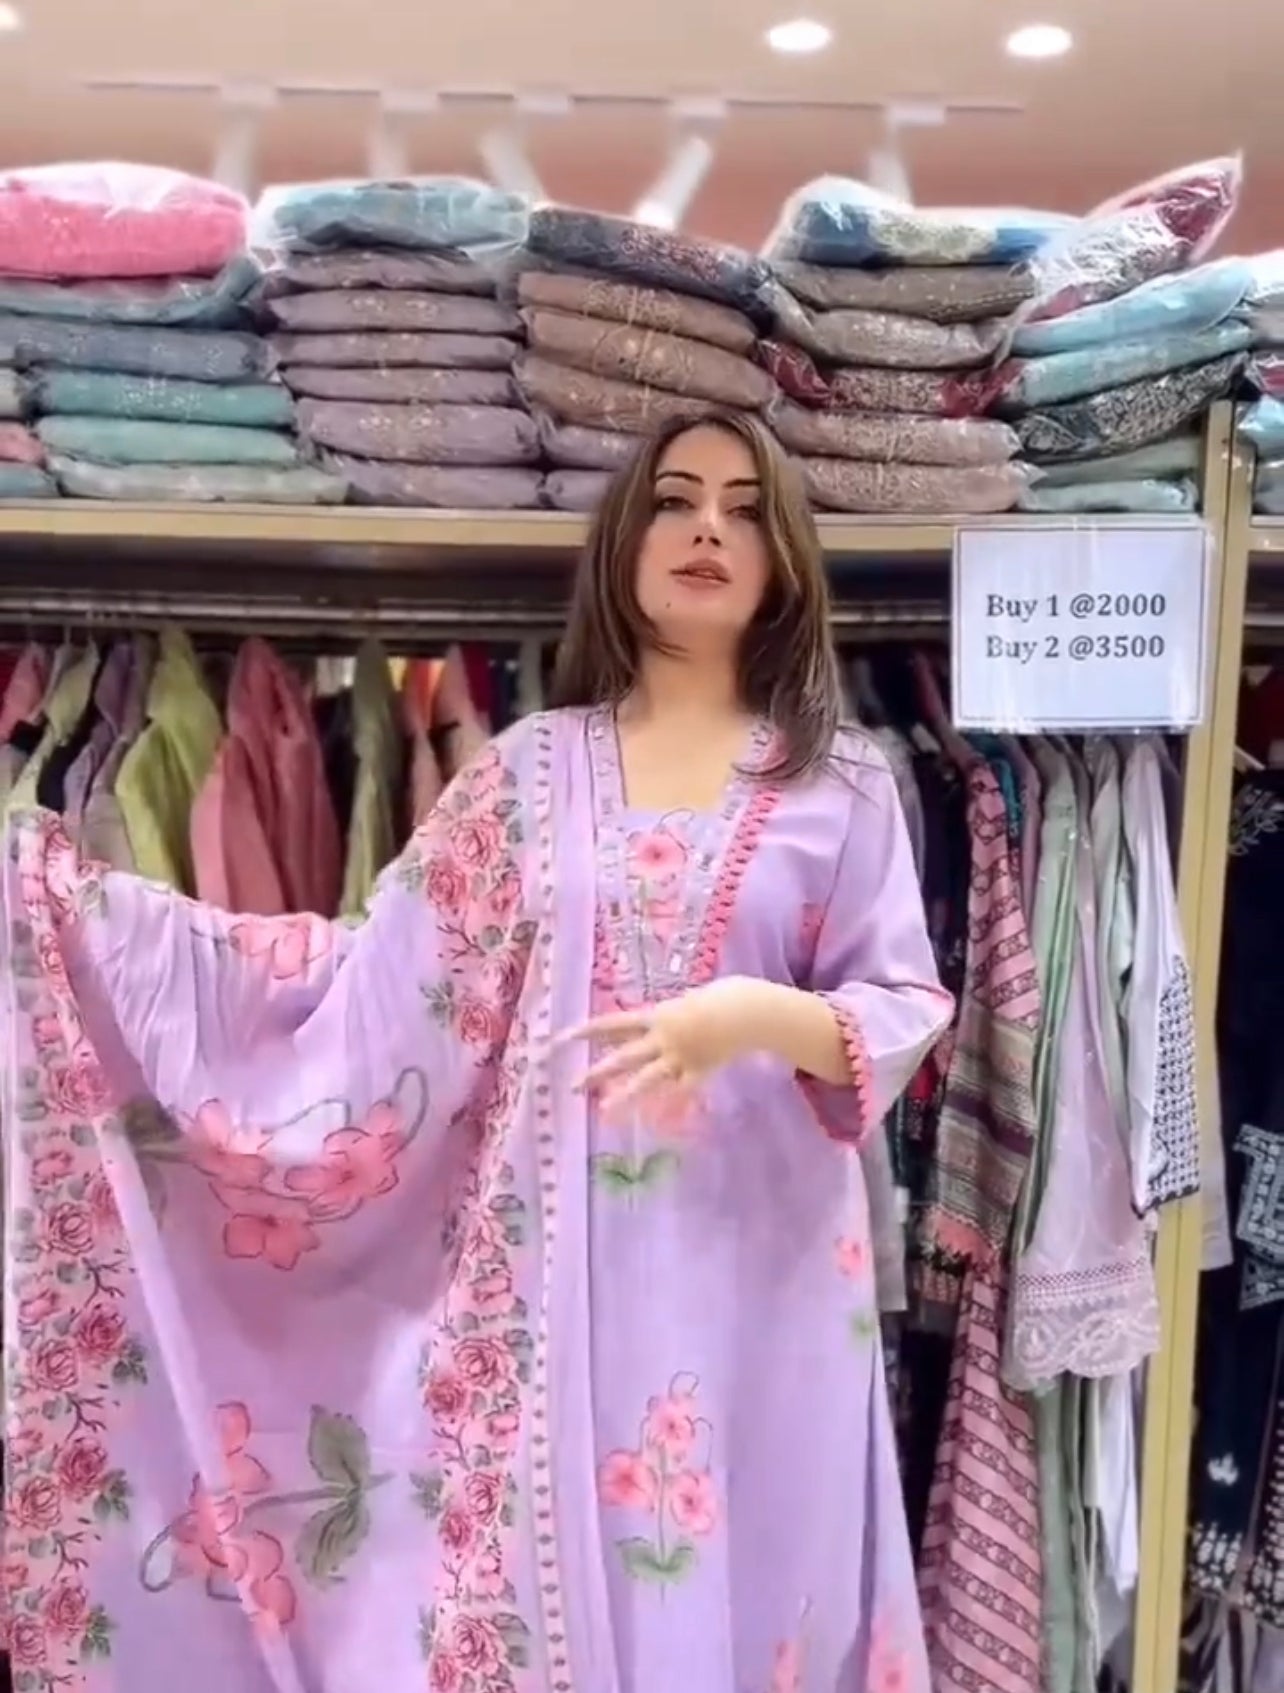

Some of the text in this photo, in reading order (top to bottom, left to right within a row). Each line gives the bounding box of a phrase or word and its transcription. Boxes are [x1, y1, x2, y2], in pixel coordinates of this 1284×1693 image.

[987, 593, 1166, 622] Buy 1 @2000
[987, 635, 1165, 664] Buy 2 @3500
